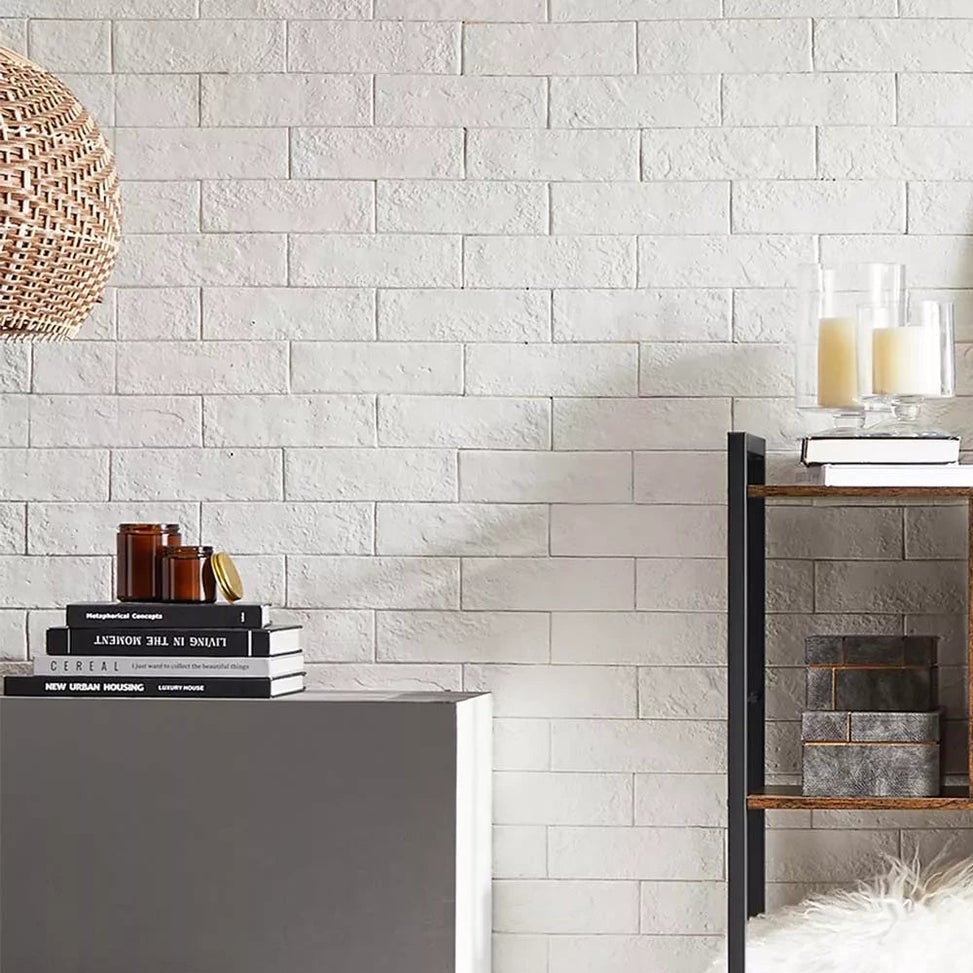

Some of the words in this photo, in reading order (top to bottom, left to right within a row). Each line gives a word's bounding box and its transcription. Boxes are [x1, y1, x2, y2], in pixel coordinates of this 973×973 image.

[94, 636, 142, 646] MOMENT
[146, 636, 168, 646] THE
[173, 637, 184, 646] IN
[190, 637, 226, 647] LIVING
[50, 660, 119, 672] CEREAL
[45, 682, 66, 691] NEW
[69, 683, 100, 691] URBAN
[103, 683, 144, 692] HOUSING
